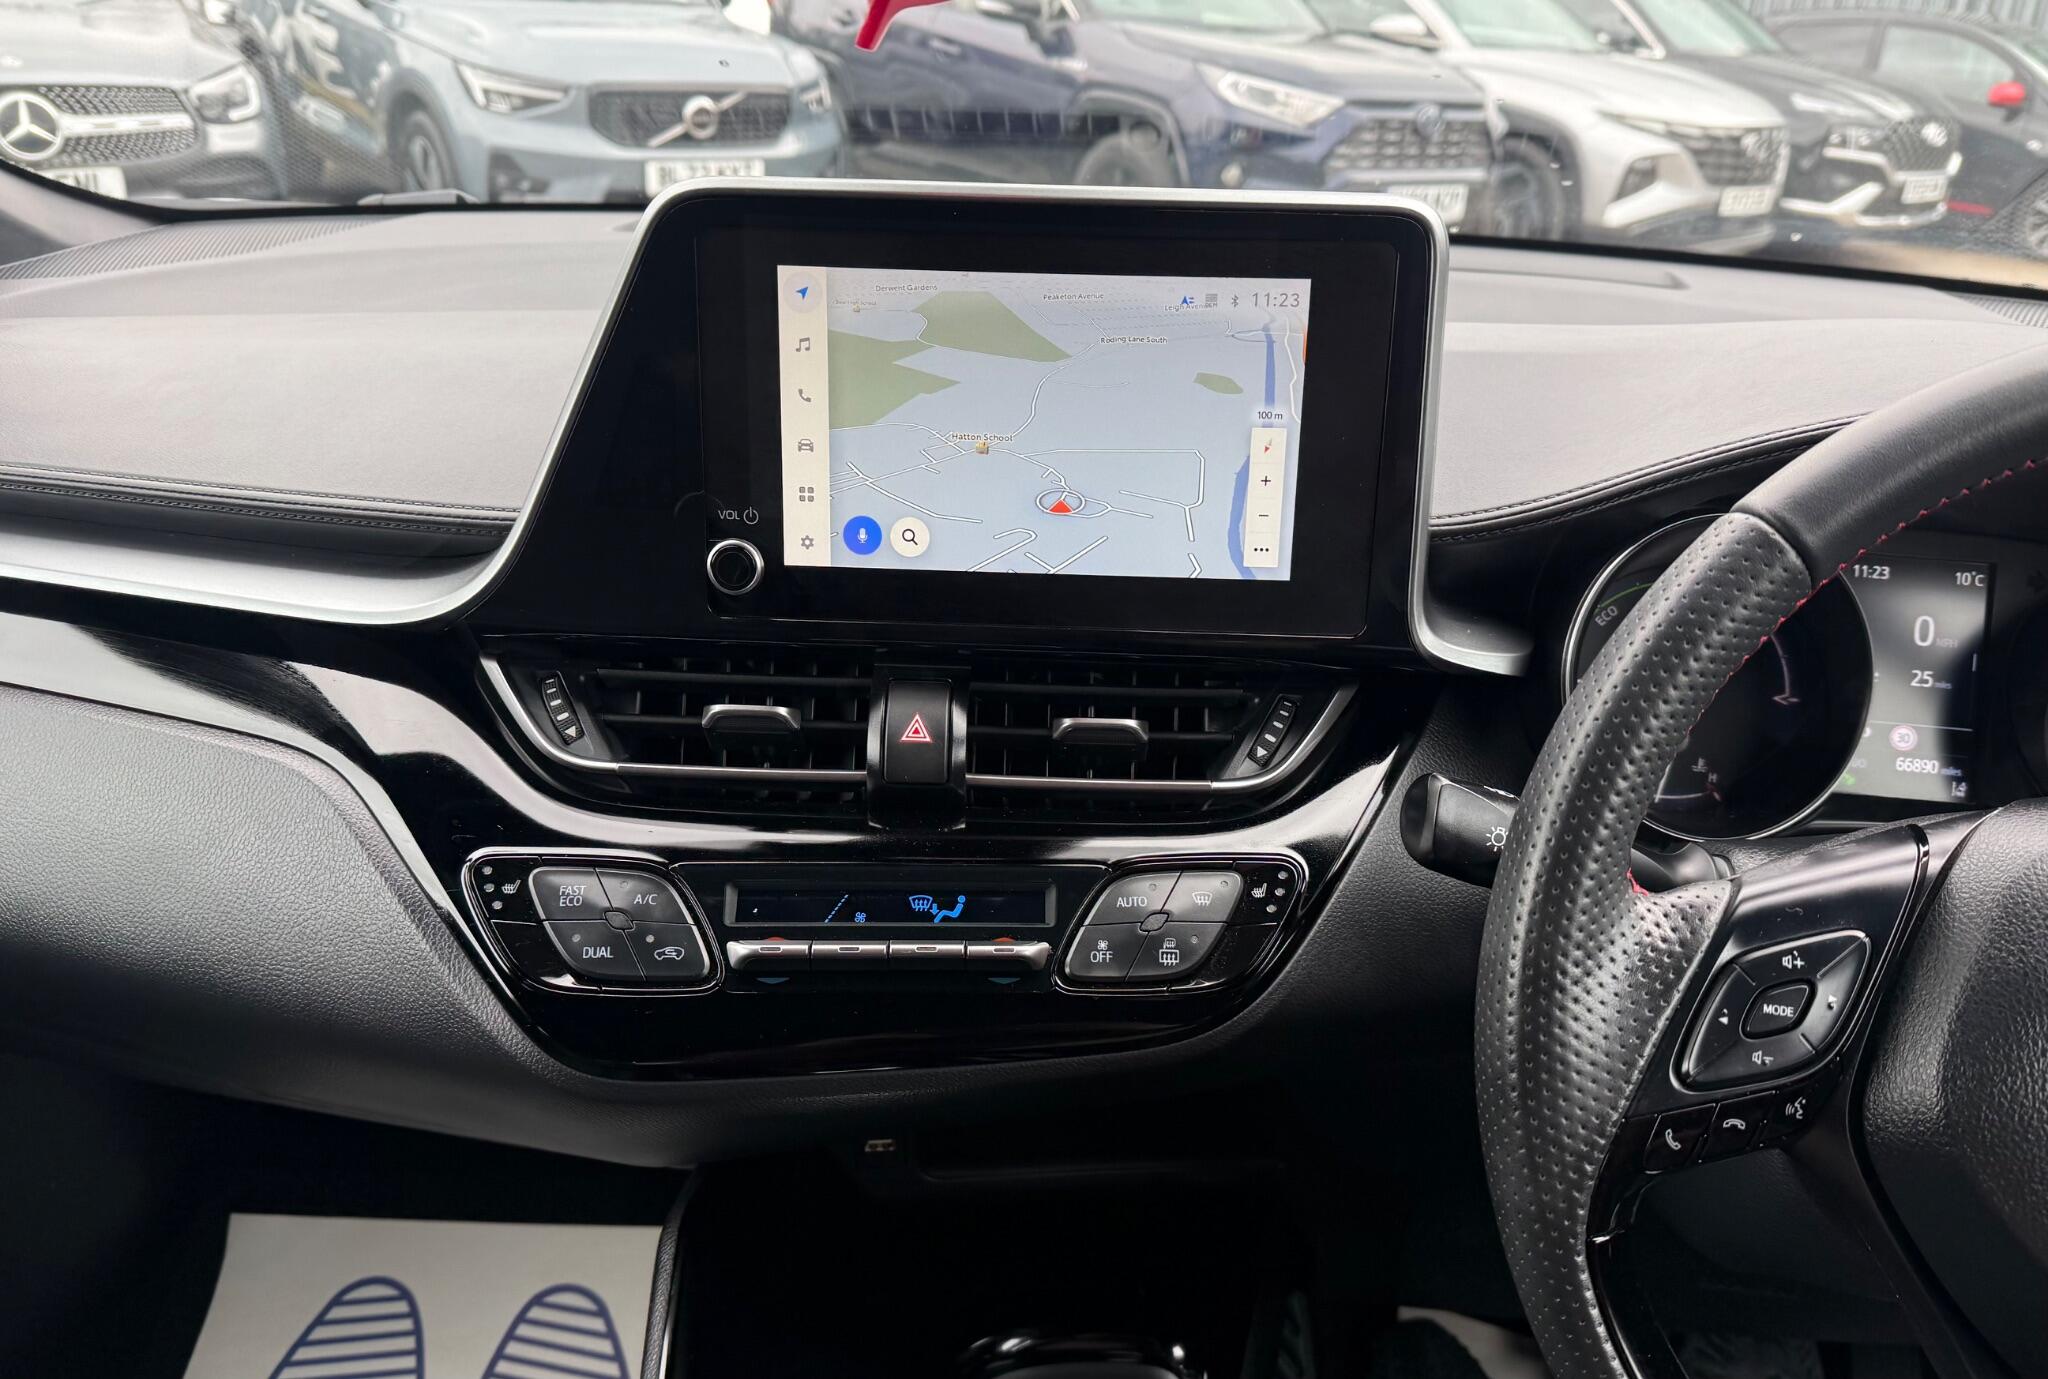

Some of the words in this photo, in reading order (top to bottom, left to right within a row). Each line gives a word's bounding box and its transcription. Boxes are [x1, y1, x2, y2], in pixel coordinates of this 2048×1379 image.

[875, 284, 906, 292] Derwent
[1252, 292, 1300, 307] 11:23
[1164, 303, 1185, 312] Leigh
[1100, 336, 1127, 344] Roding
[1146, 336, 1168, 344] South
[1257, 411, 1273, 420] 100
[951, 433, 982, 441] Hatton
[983, 433, 1013, 442] School
[718, 509, 741, 521] VOL
[1852, 564, 1891, 579] 11:23
[1594, 606, 1618, 626] ECO
[1913, 615, 1935, 647] 0
[1909, 669, 1935, 688] 25
[1897, 732, 1910, 744] 30
[1895, 756, 1940, 774] 66890
[1707, 772, 1718, 783] H
[559, 885, 587, 896] FAST
[559, 896, 583, 907] ECO
[633, 893, 658, 905] A/C
[1116, 896, 1148, 908] AUTO
[582, 946, 614, 959] DUAL
[1090, 950, 1114, 963] OFF
[1762, 1003, 1794, 1018] MODE
